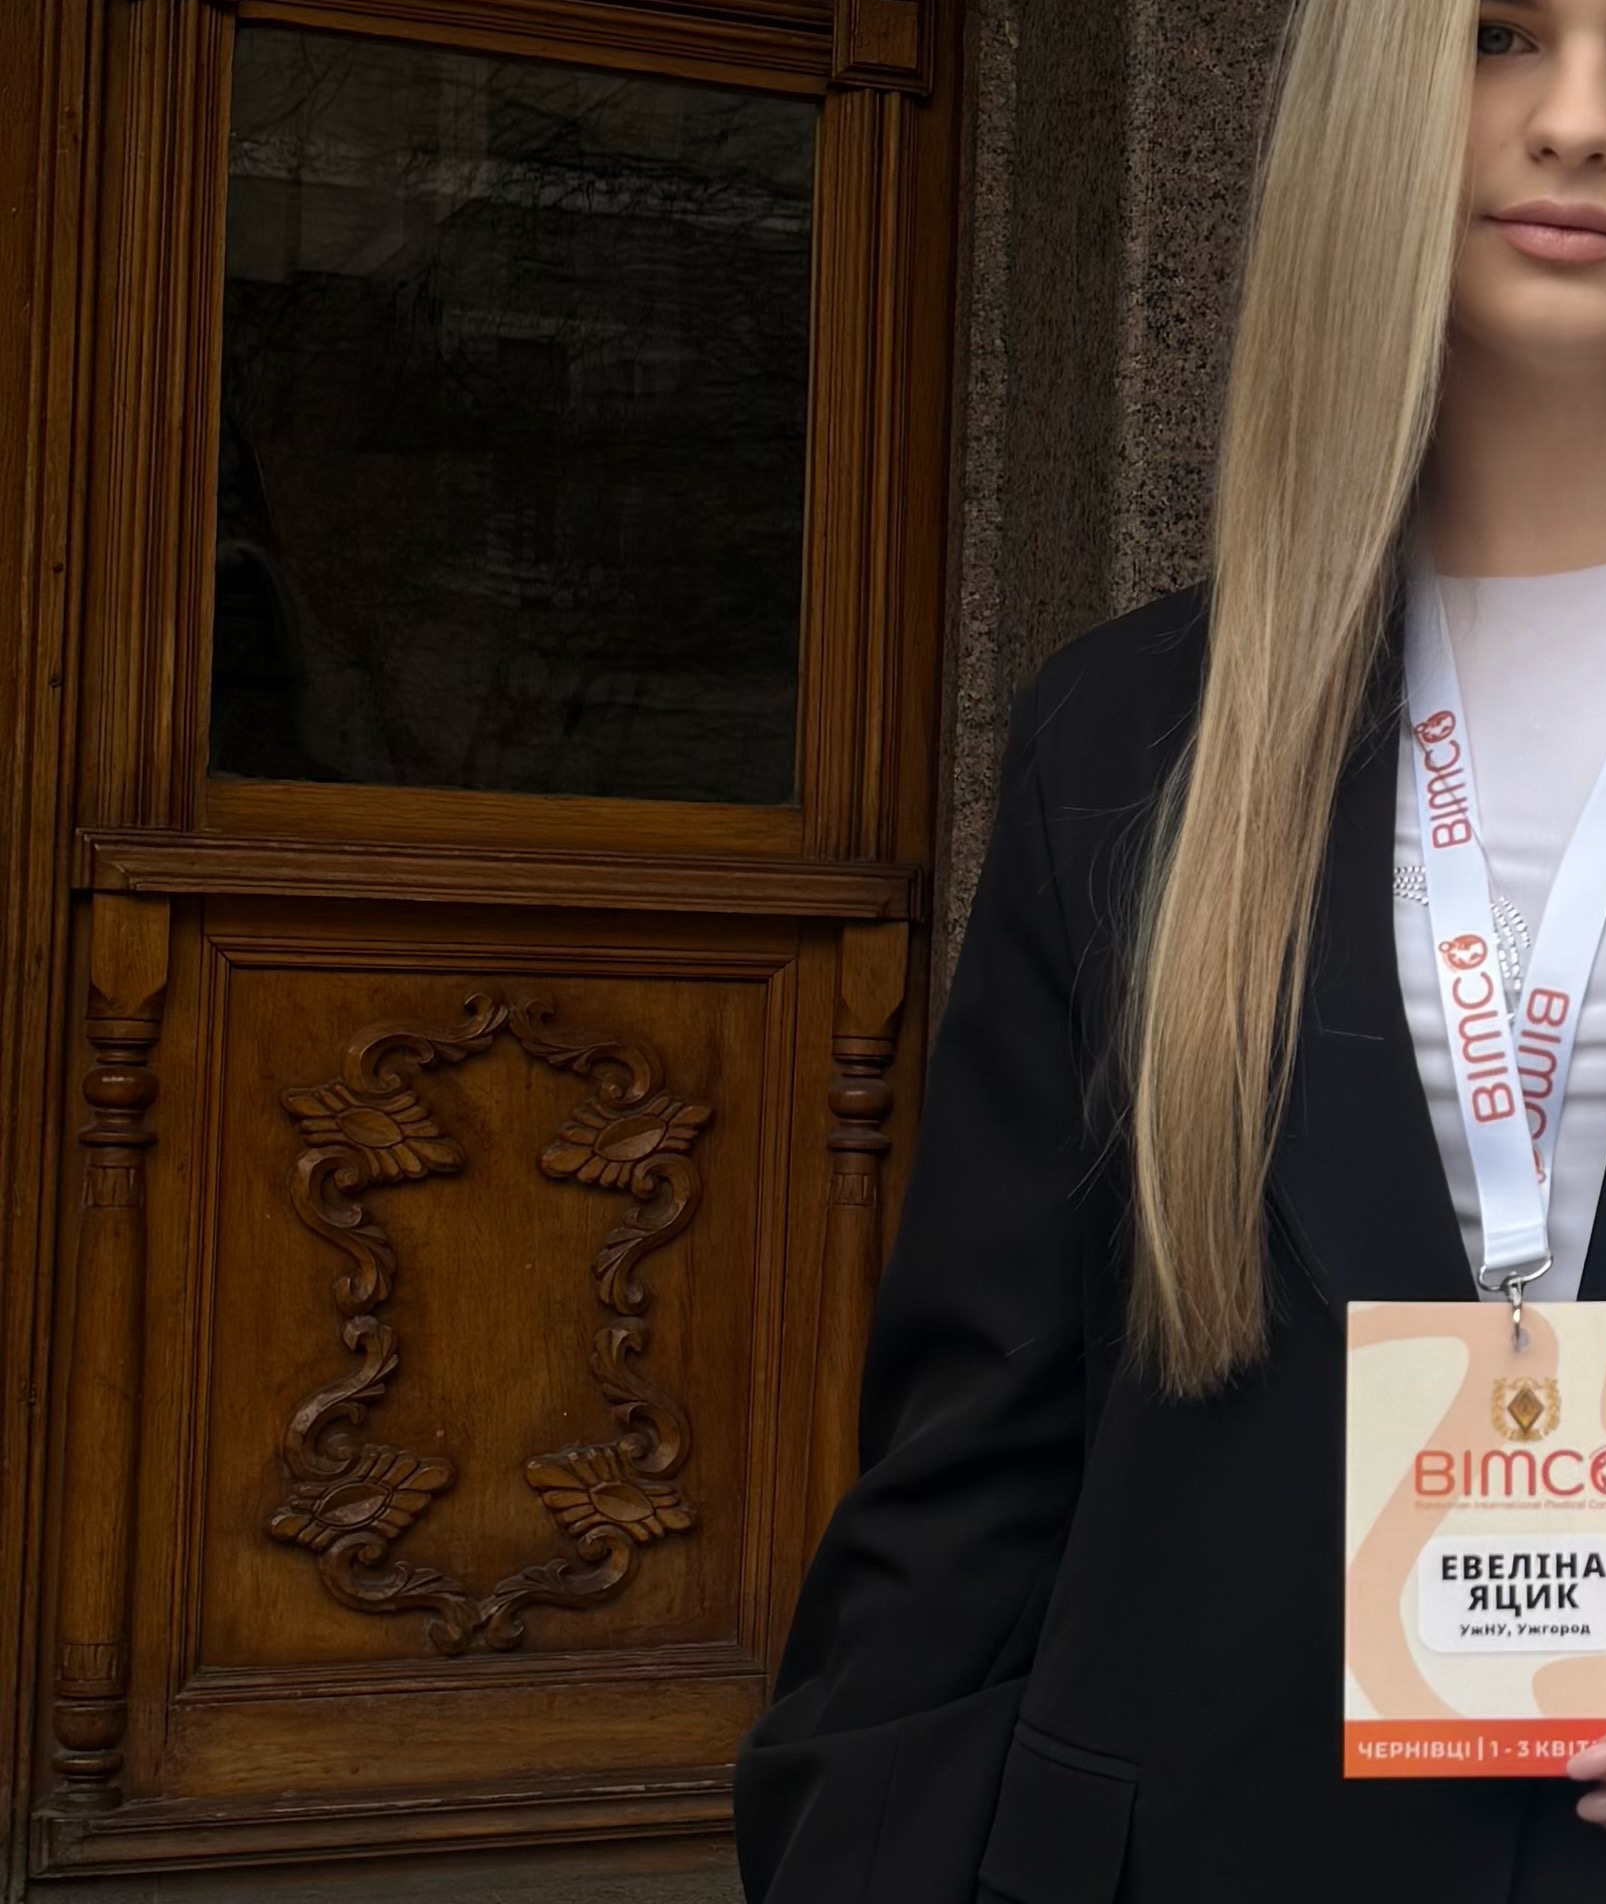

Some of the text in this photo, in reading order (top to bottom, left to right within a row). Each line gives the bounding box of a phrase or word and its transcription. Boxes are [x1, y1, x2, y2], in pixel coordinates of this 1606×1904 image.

[1517, 987, 1571, 1185] BIMC
[1468, 1583, 1580, 1617] ЯЦИК
[1459, 1623, 1591, 1637] УжНУ, Ужгород
[1357, 1740, 1471, 1761] ЧЕРНІВЦІ
[1490, 1740, 1499, 1758] 1
[1517, 1740, 1530, 1758] 3
[1535, 1739, 1597, 1758] КВІТ
